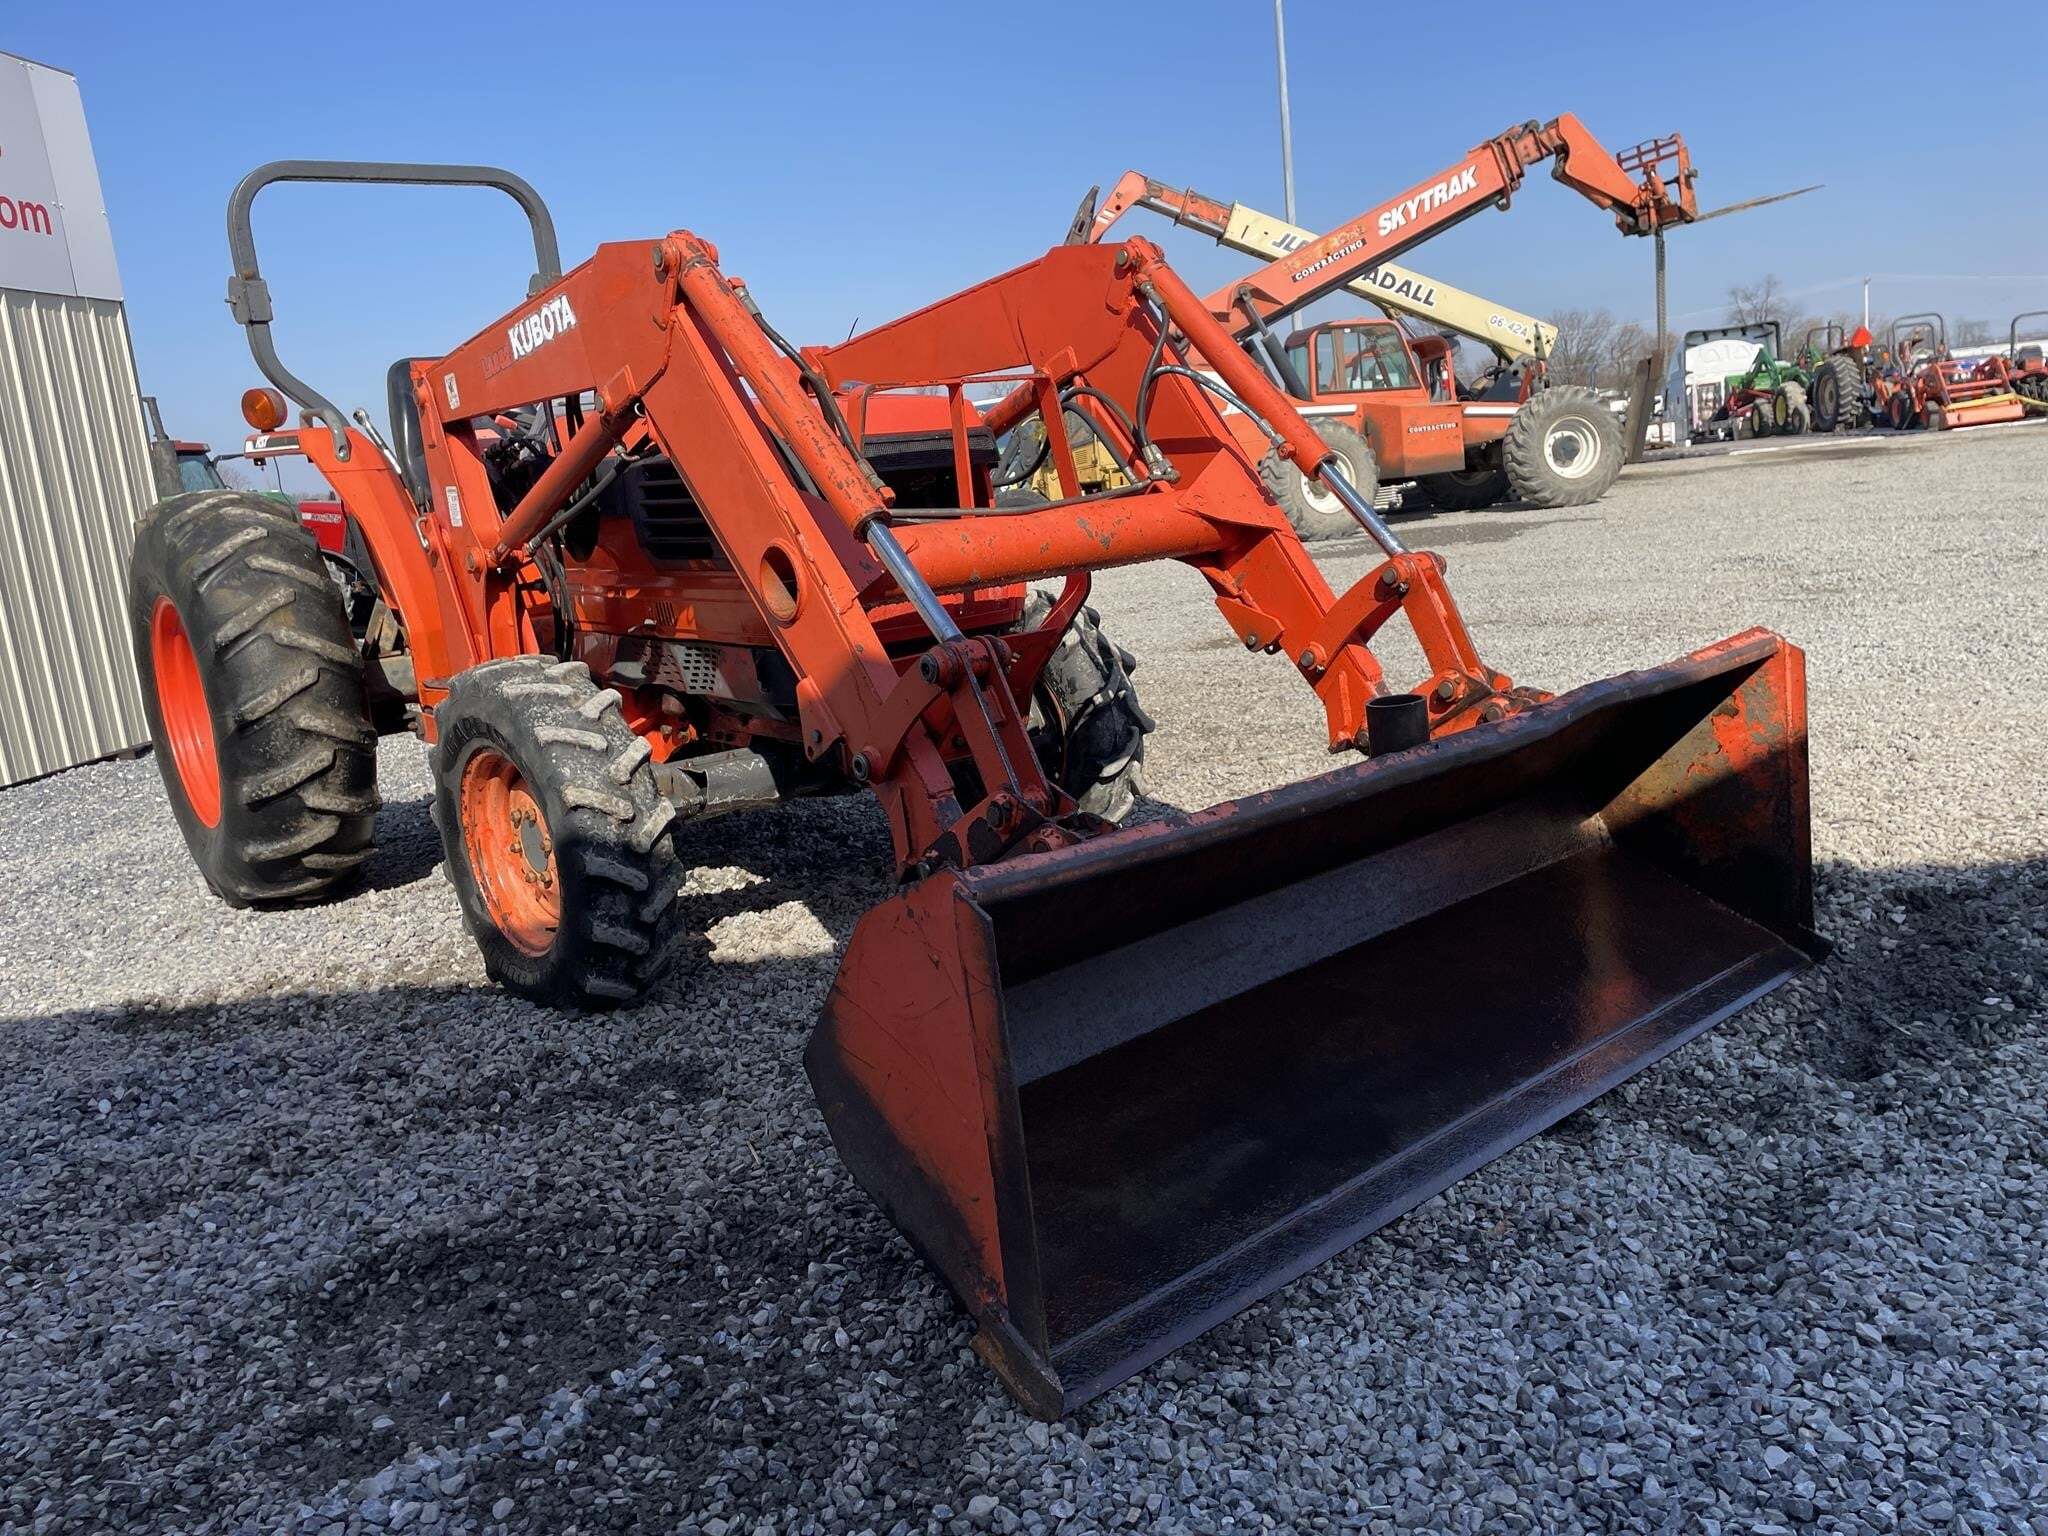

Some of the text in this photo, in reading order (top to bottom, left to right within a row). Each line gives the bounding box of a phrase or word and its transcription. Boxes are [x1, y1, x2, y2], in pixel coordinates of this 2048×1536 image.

[1377, 165, 1478, 237] SKYTRAK
[1294, 239, 1364, 282] CONTRACTING
[507, 294, 576, 361] KUBOTA
[1408, 422, 1457, 434] CONTRACTING
